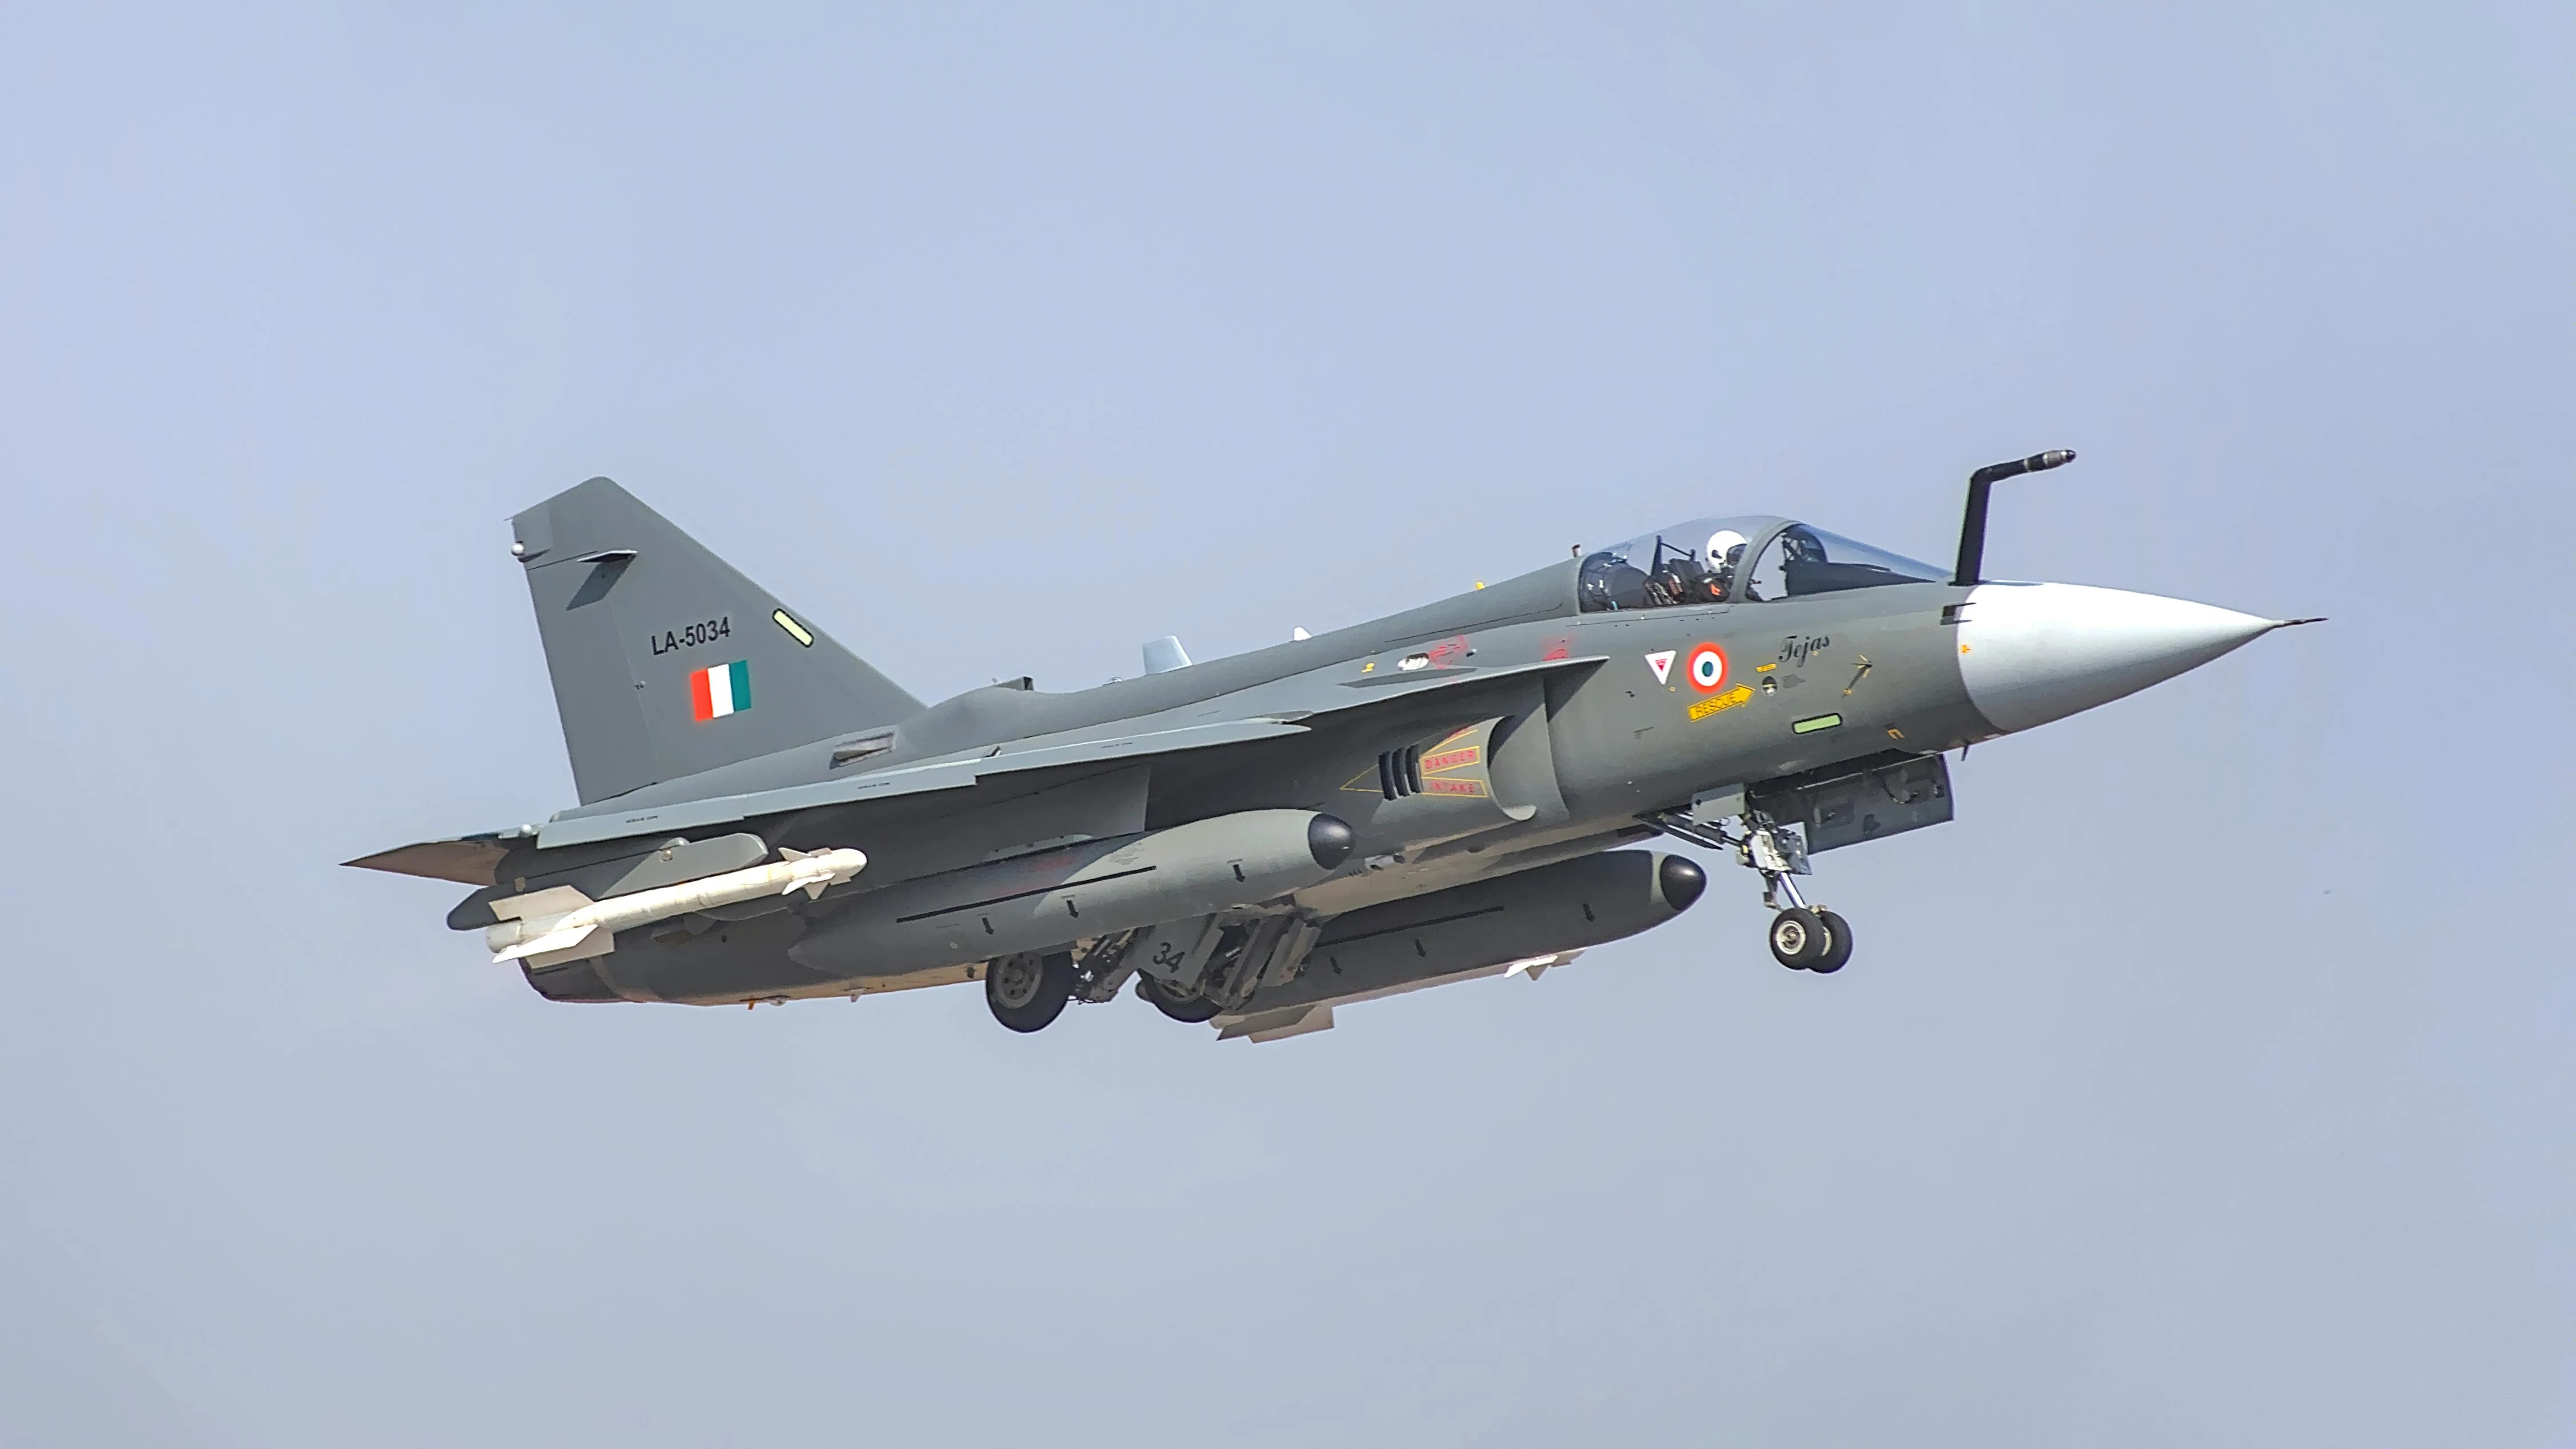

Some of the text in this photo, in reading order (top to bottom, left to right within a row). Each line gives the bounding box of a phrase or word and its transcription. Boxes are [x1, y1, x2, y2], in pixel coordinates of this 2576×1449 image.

[651, 616, 731, 655] LA-5034
[1778, 635, 1830, 668] Tejas
[1694, 692, 1737, 716] RESCUE
[1153, 942, 1186, 973] 34
